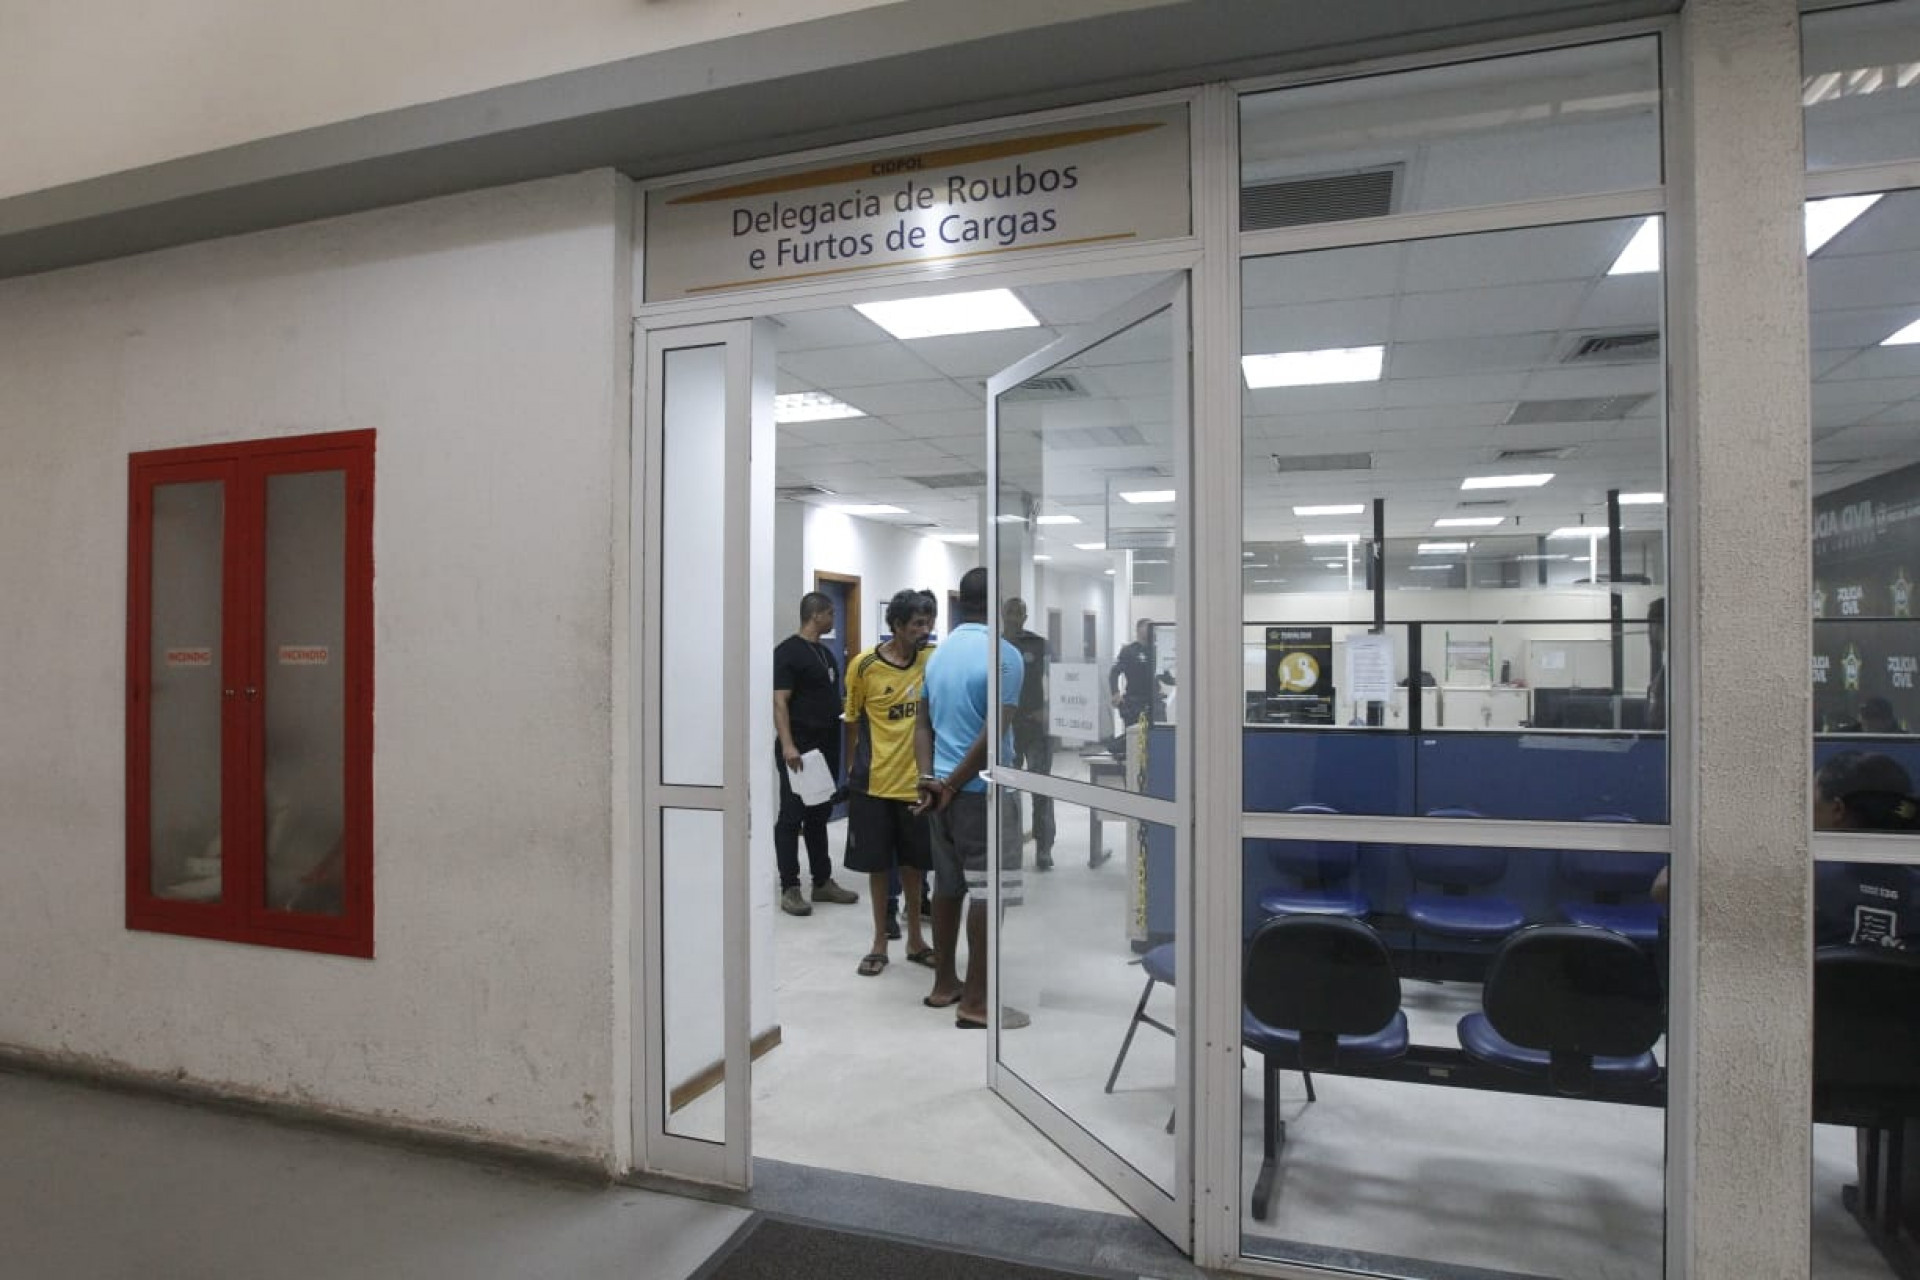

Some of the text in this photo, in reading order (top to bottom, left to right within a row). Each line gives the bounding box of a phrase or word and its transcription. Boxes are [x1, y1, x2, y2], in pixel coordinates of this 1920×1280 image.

[733, 164, 1078, 237] Delegacia de Roubos
[750, 208, 1057, 270] e Furtos de Cargas
